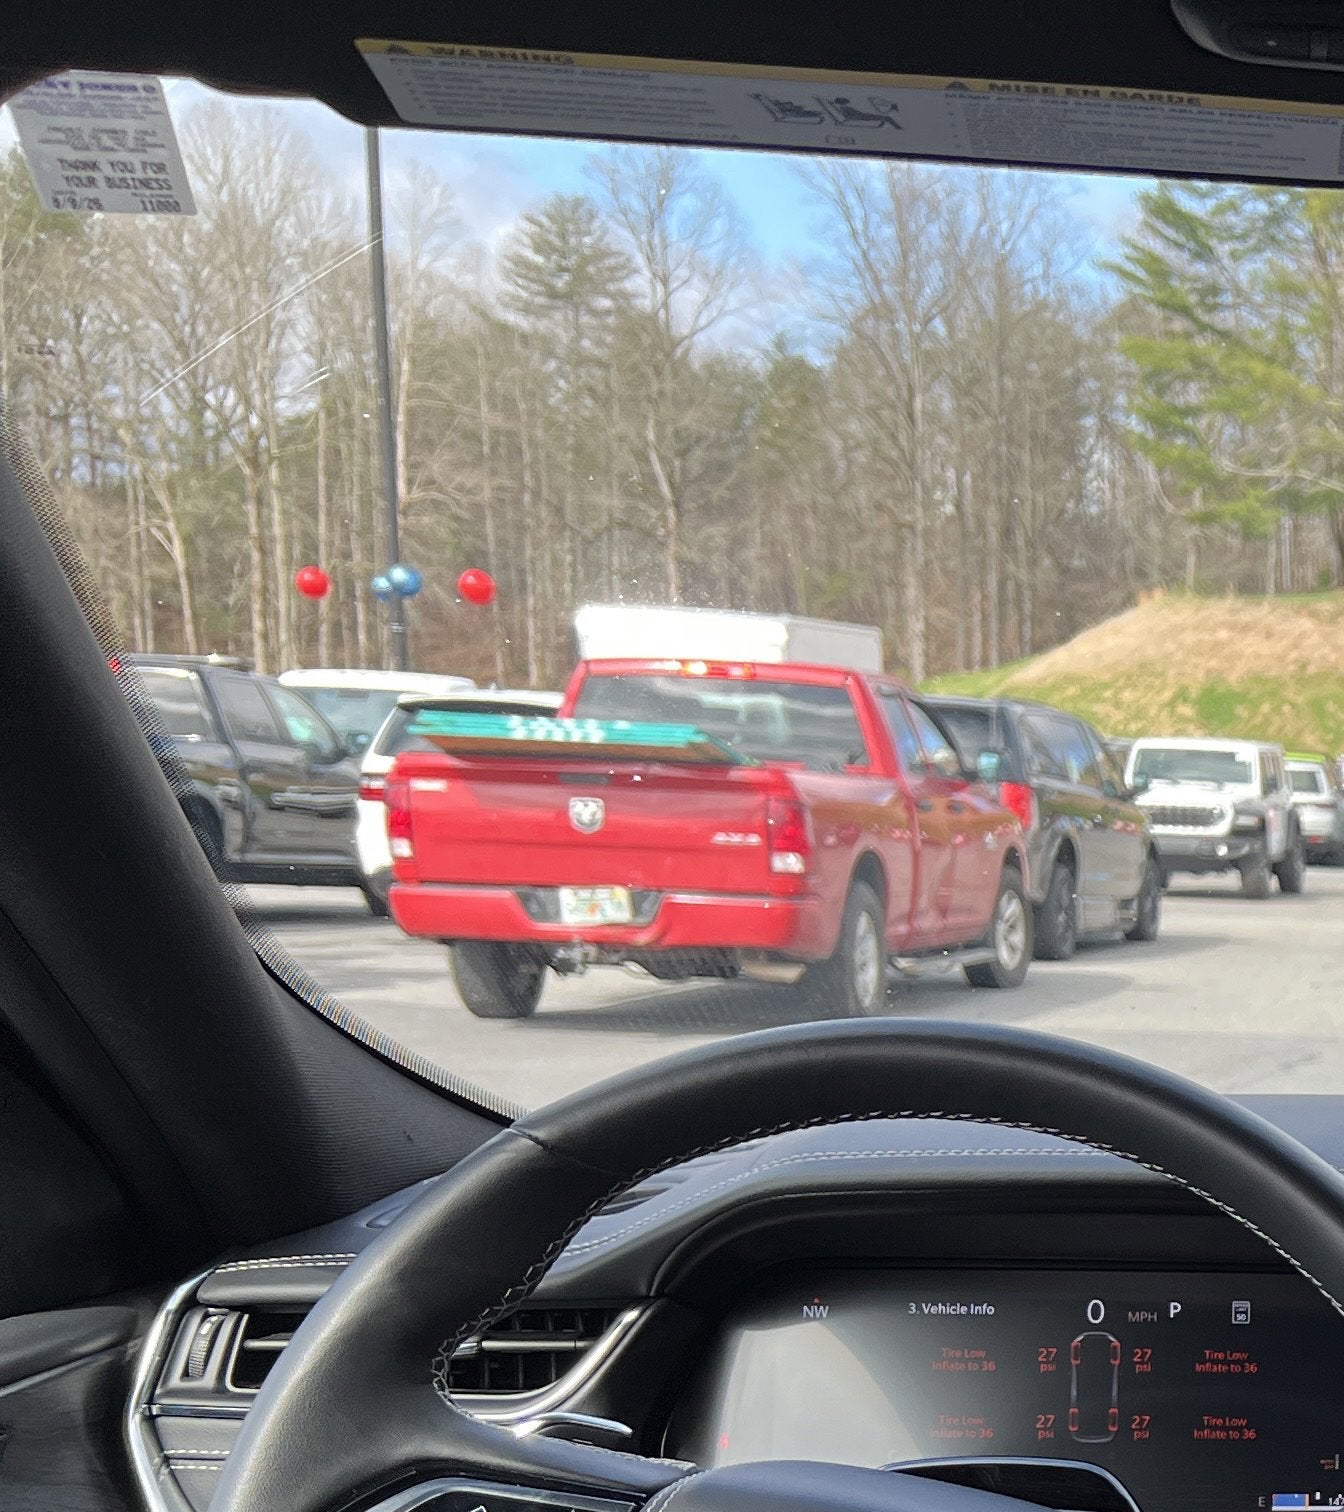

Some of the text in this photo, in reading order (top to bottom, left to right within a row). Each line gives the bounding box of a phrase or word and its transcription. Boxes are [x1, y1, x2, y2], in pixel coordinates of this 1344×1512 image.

[57, 158, 168, 175] THANK YOU FOR
[63, 175, 173, 191] YOUR BUSINESS
[802, 1305, 829, 1319] NW
[908, 1302, 995, 1316] 3. Vehicle Info
[1087, 1299, 1105, 1325] 0
[1169, 1302, 1182, 1319] P
[1127, 1311, 1158, 1323] MPH
[942, 1348, 986, 1359] Tire Low
[1037, 1348, 1058, 1362] 27
[1132, 1348, 1152, 1362] 27
[1204, 1349, 1249, 1361] Tire Low
[932, 1360, 996, 1372] Inflate to 36
[1039, 1362, 1057, 1373] psi
[1135, 1362, 1152, 1374] psi
[1195, 1362, 1258, 1374] Inflate to 36
[939, 1414, 984, 1425] Tire Low
[1035, 1414, 1056, 1428] 27
[1131, 1415, 1151, 1429] 27
[1202, 1416, 1248, 1427] Tire Low
[929, 1428, 964, 1438] Inflate
[979, 1427, 994, 1439] 36
[1037, 1429, 1055, 1440] psi
[1133, 1429, 1150, 1441] psi
[1193, 1428, 1256, 1440] Inflate to 36
[1258, 1496, 1266, 1507] E
